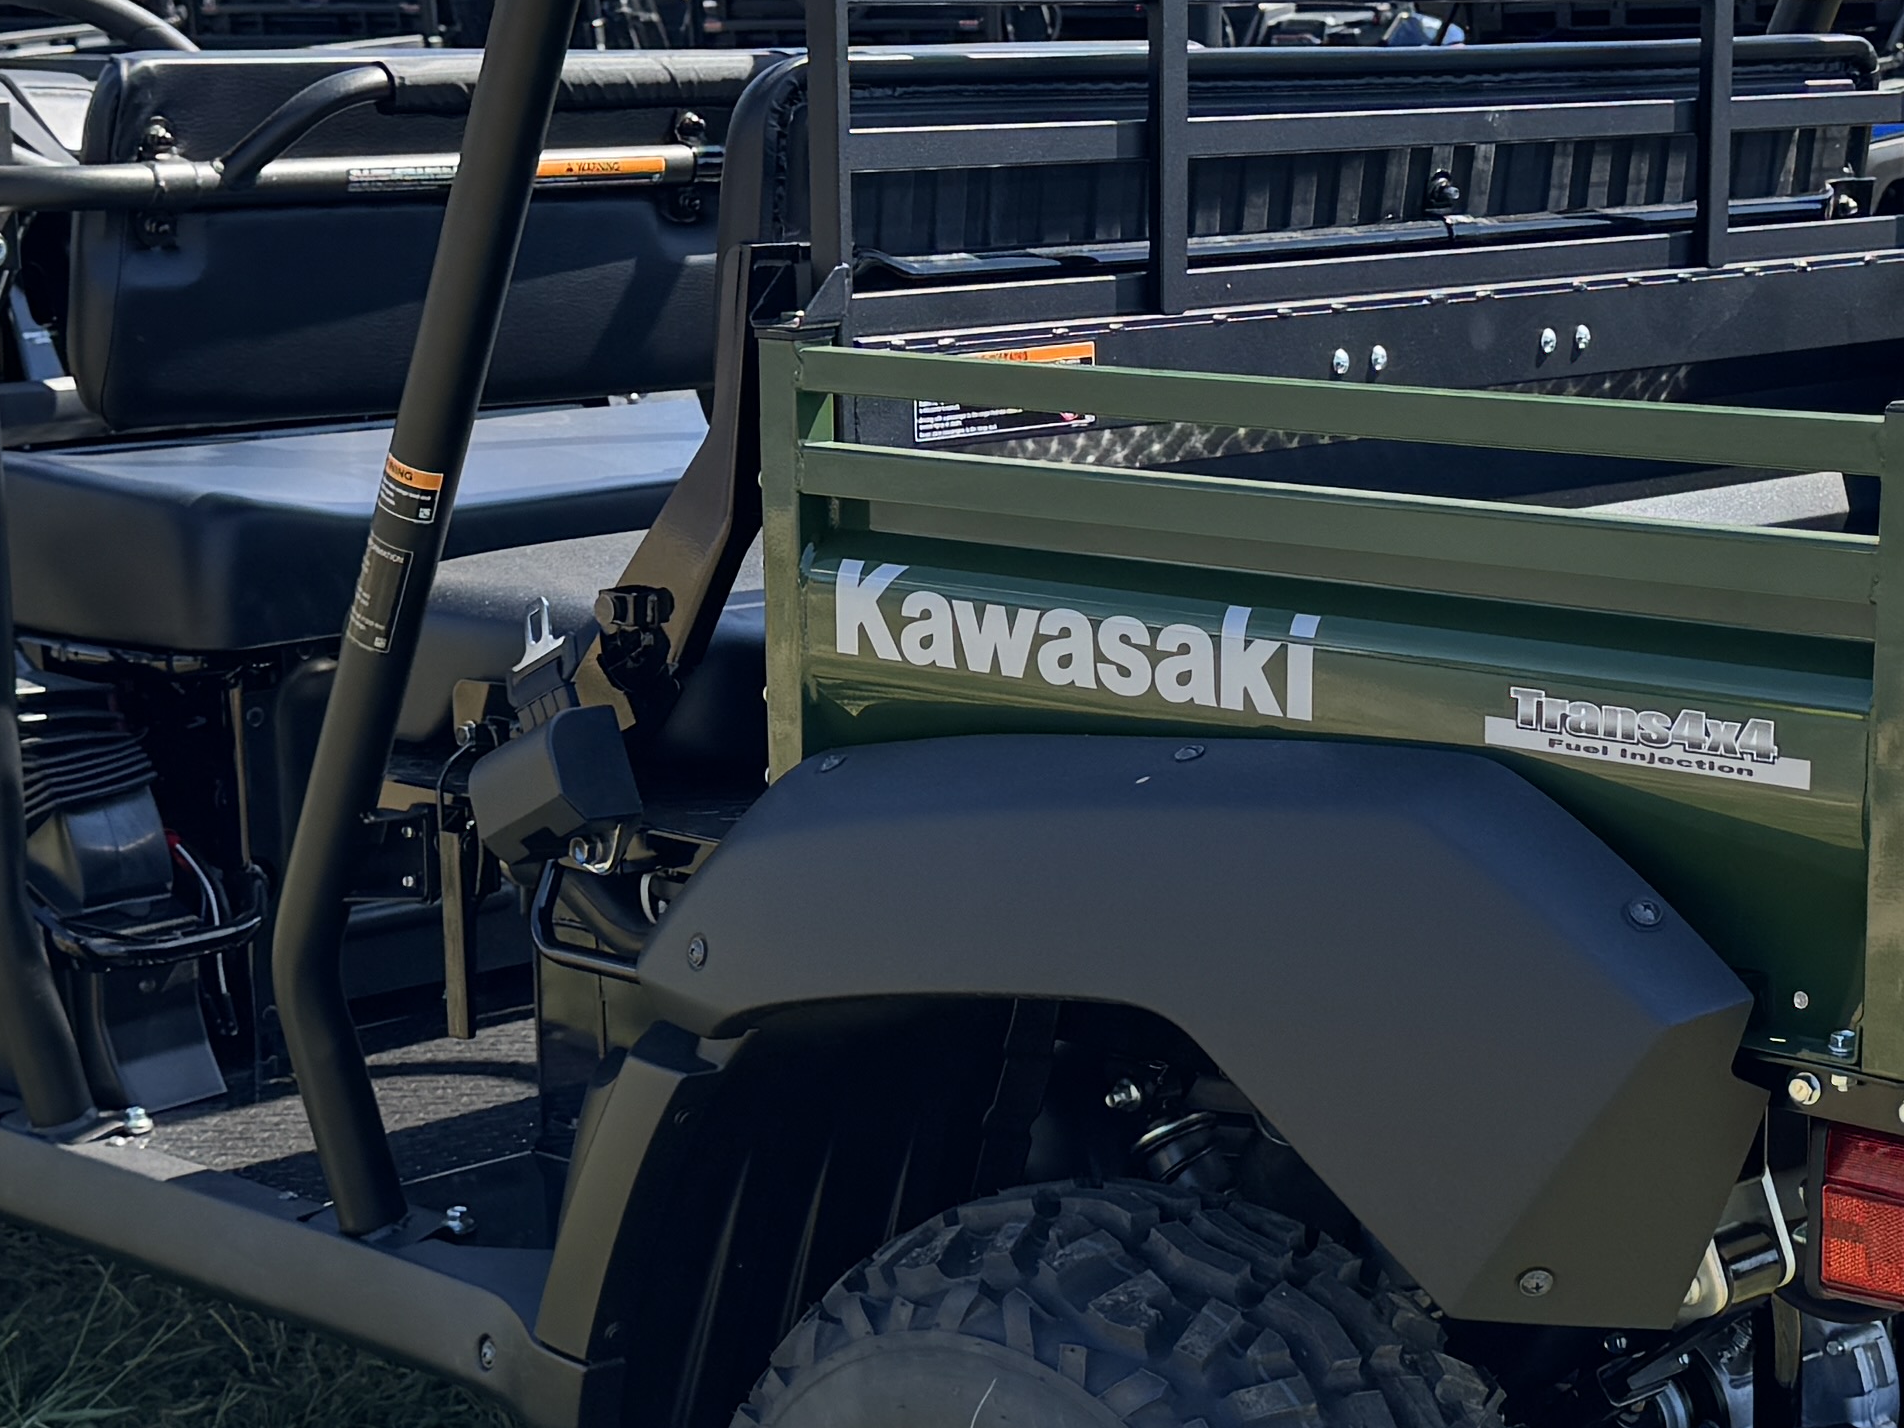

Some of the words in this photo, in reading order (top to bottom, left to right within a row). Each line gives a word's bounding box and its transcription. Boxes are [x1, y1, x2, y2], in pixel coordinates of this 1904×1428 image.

[835, 558, 1322, 722] Kawasaki
[1509, 686, 1779, 765] Trans4x4
[1548, 737, 1609, 757] Fuel
[1619, 747, 1756, 778] Injection
